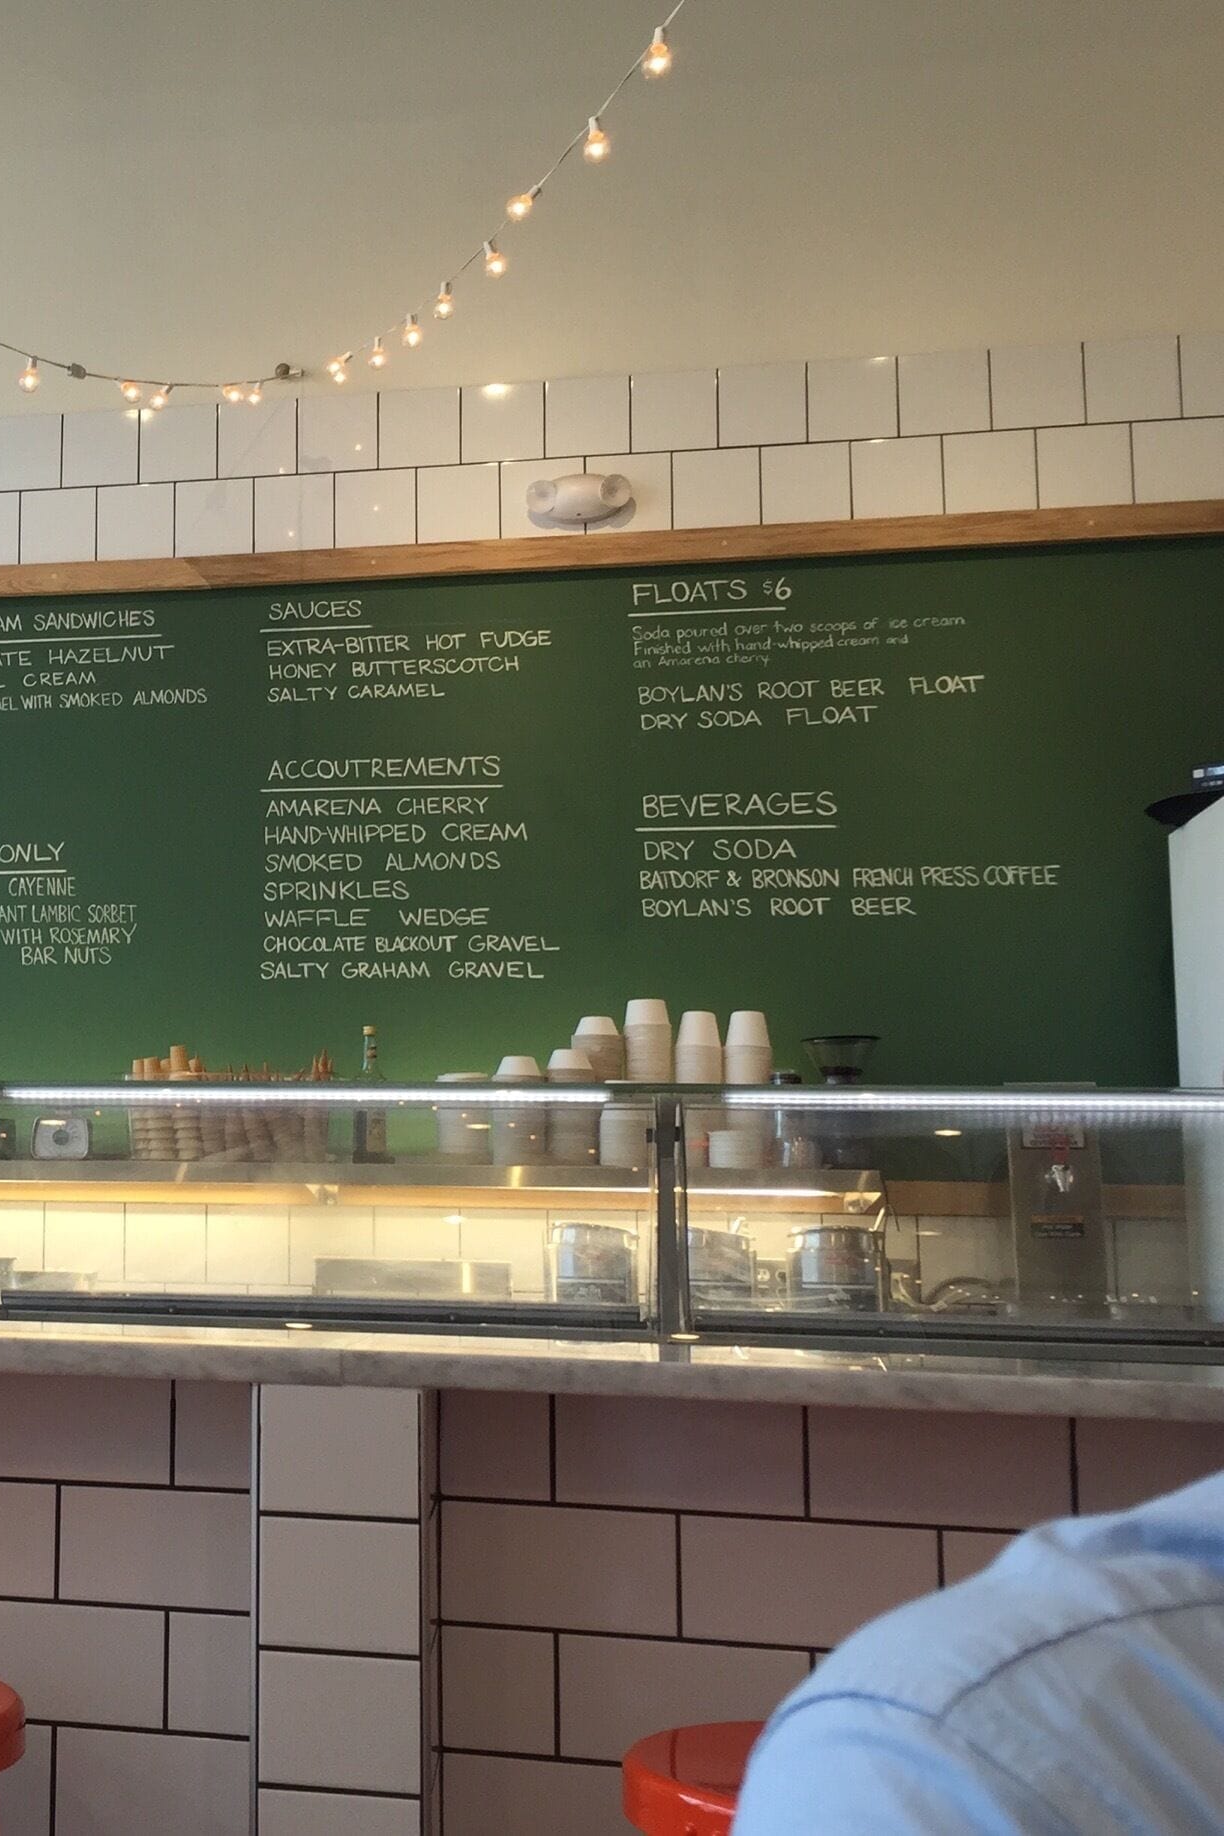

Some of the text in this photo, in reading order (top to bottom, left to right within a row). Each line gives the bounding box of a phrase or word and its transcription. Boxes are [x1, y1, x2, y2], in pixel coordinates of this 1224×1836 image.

[633, 577, 792, 605] FLOATS $6
[33, 610, 155, 631] SANDWICHES
[269, 600, 361, 620] SAUCES
[632, 617, 966, 643] Soda poured over two scoops of ice cream
[267, 630, 552, 656] EXTRA-BITTER HOT FUDGE
[634, 634, 909, 656] Finished with hand-whipped cream and
[49, 645, 175, 664] HAZELNUT
[633, 653, 770, 668] an Amarena cherry
[269, 656, 519, 680] HONEY BUTTERSCOTCH
[23, 671, 96, 687] CREAM
[20, 694, 52, 709] WITH
[59, 692, 123, 708] SMOKED
[133, 688, 207, 705] ALMONDS
[267, 684, 445, 702] SALTY CARAMEL
[638, 675, 984, 705] BOYLAN'S ROOT BEER FLOAT
[641, 706, 878, 730] DRY SODA FLOAT
[268, 756, 500, 781] ACCOUTREMENTS
[266, 797, 488, 817] AMARENA CHERRY
[643, 791, 837, 818] BEVERAGES
[265, 823, 527, 845] HAND-WHIPPED CREAM
[644, 839, 797, 860] DRY SODA
[265, 851, 501, 873] SMOKED ALMONDS
[9, 877, 75, 896] CAYENNE
[640, 865, 1060, 889] BATDORF & BRONSON FRENCH PRESS COFFEE
[264, 880, 409, 901] SPRINKLES
[265, 908, 490, 927] WAFFLE WEDGE
[642, 897, 916, 917] BOYLAN'S ROOT BEER
[264, 935, 560, 953] CHOCOLATE BLACKOUT GRAVEL
[260, 961, 544, 979] SALTY GRAHAM GRAVEL
